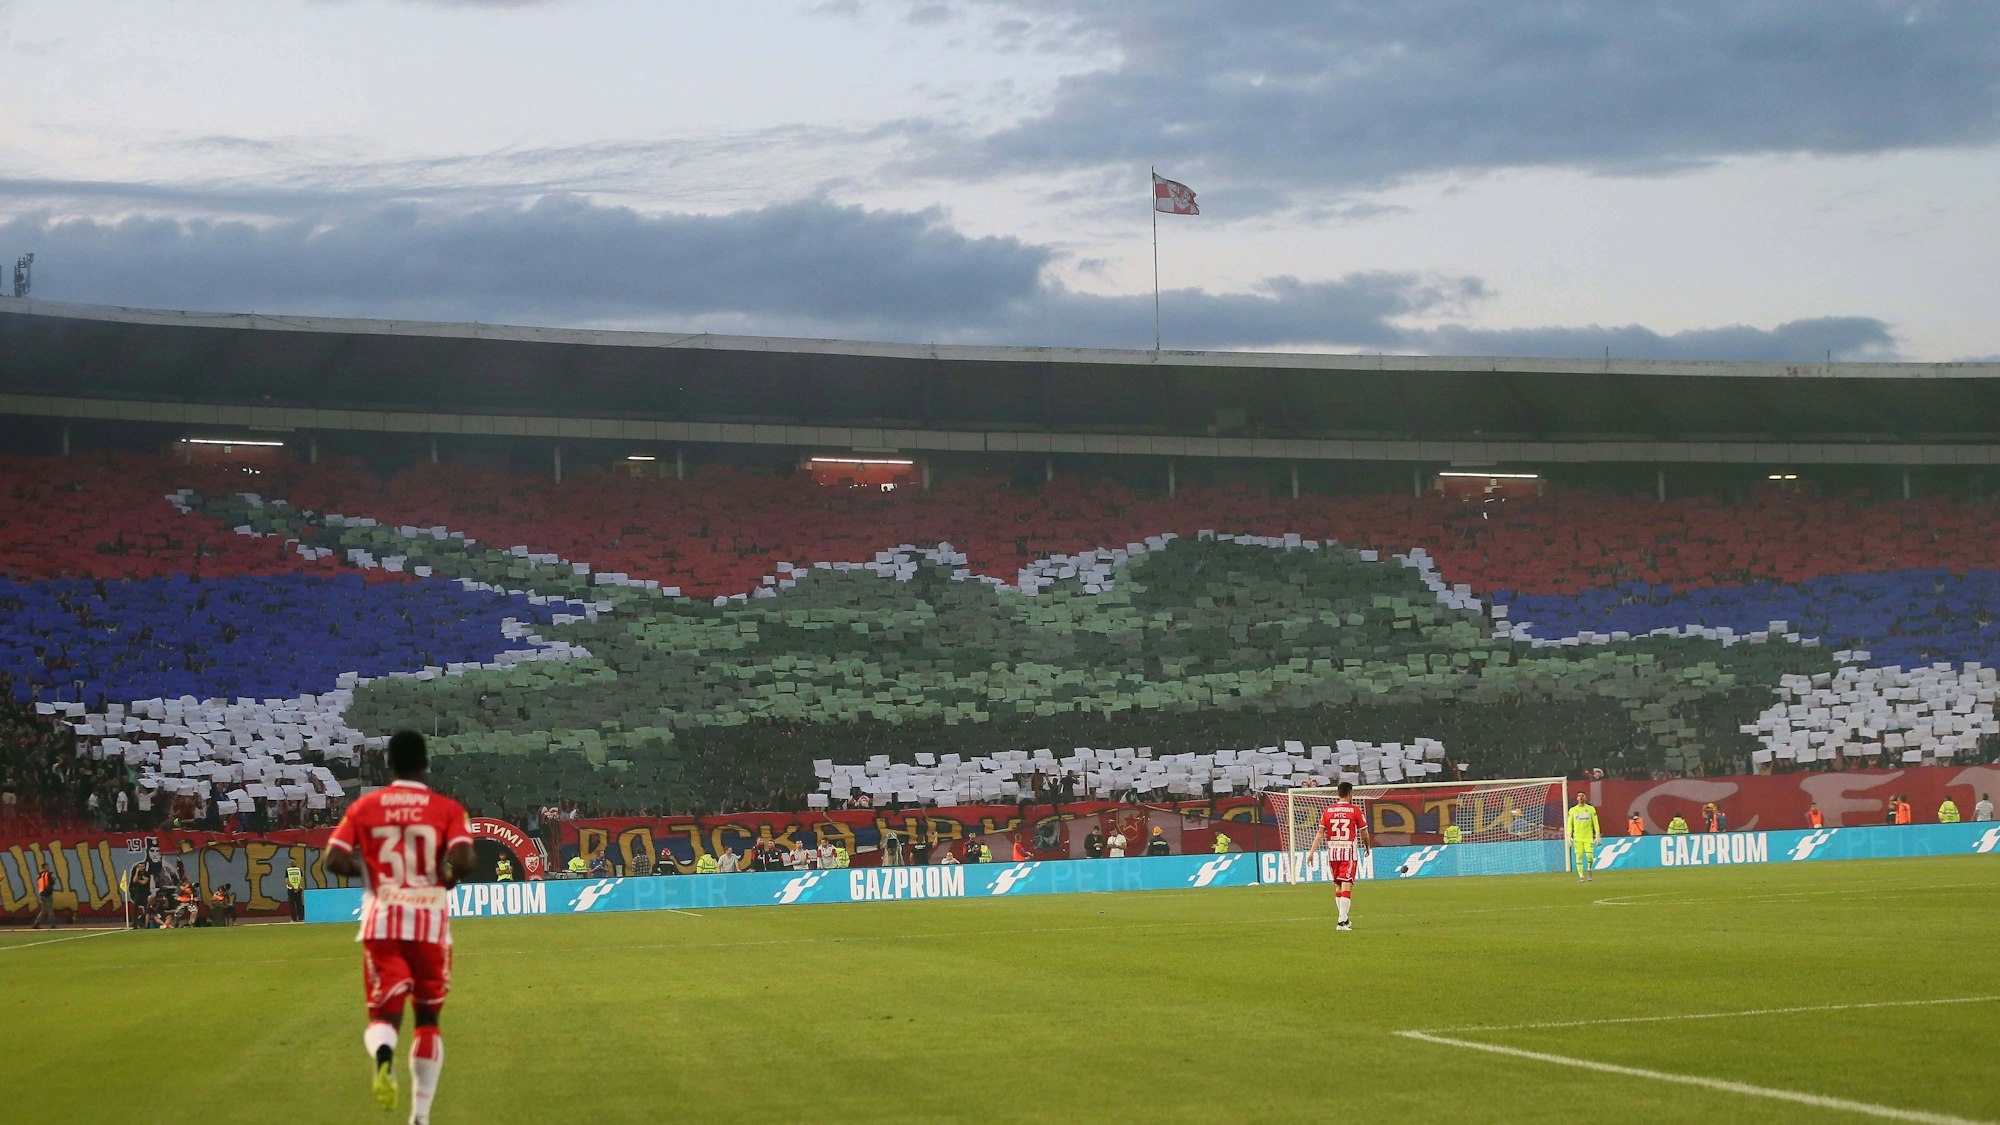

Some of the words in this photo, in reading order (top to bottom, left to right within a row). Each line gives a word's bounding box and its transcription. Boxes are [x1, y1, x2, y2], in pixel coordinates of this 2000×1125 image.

[470, 822, 481, 834] Е
[483, 822, 524, 848] ТИМ!
[1329, 819, 1351, 841] 33
[371, 824, 438, 888] 30
[1660, 832, 1768, 866] GAZPROM
[1261, 849, 1374, 884] GAZPRM
[447, 882, 547, 917] AZPROM
[850, 866, 965, 900] GAZPROM
